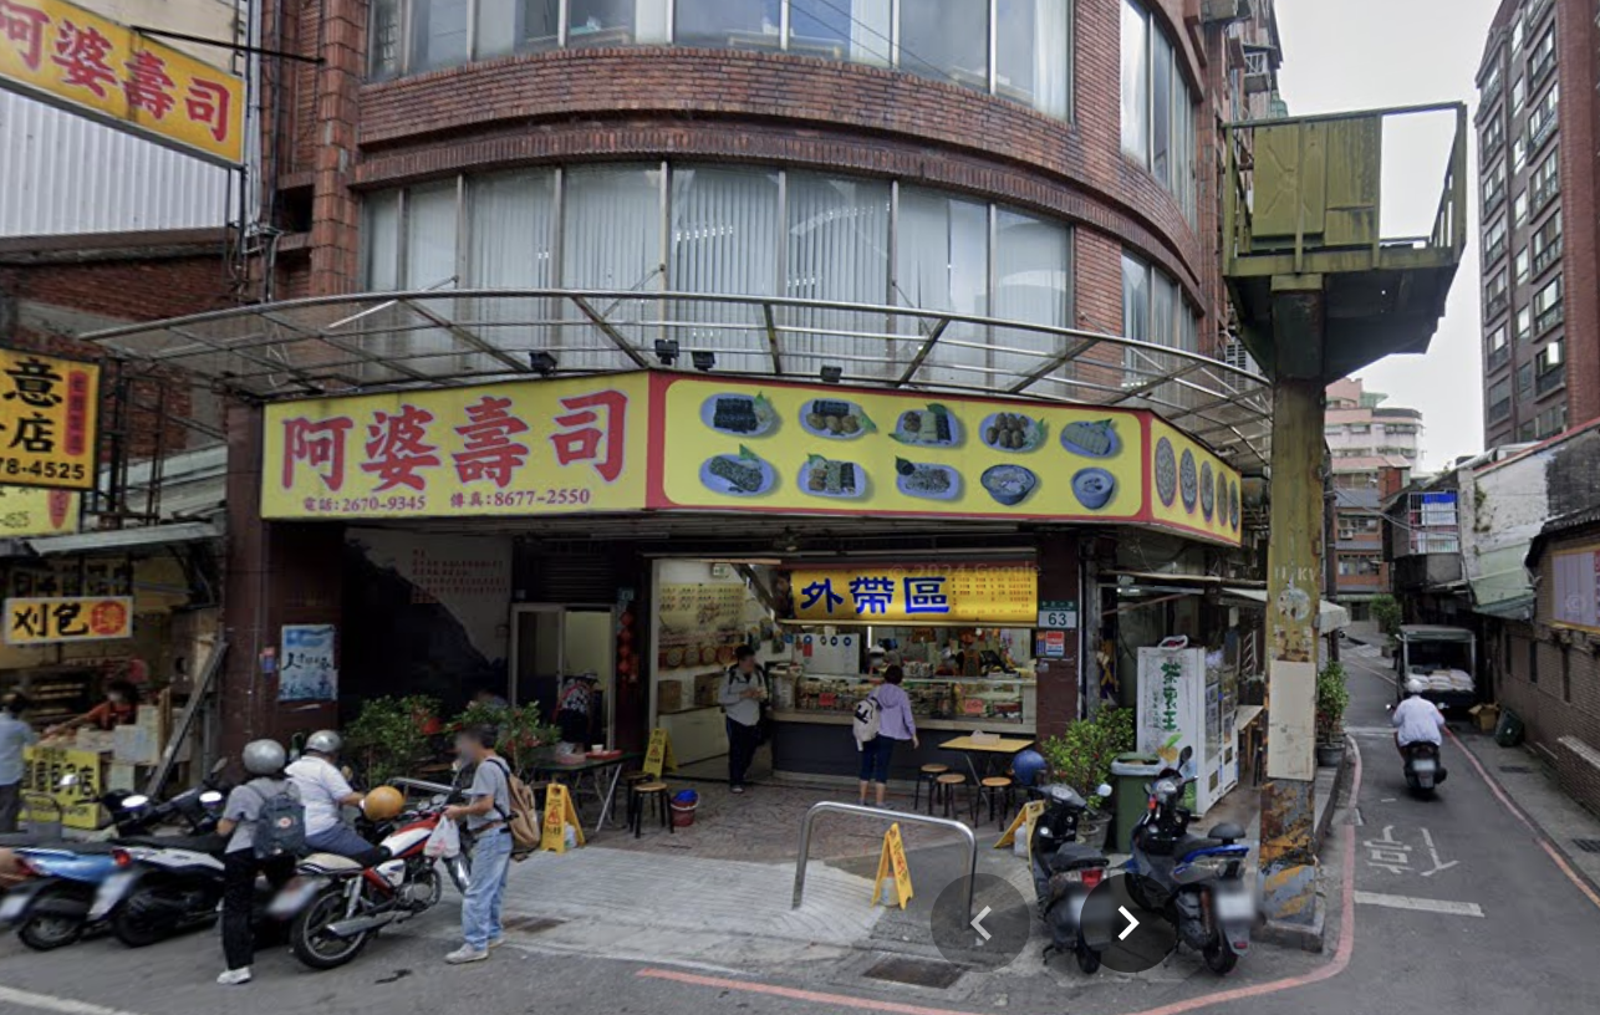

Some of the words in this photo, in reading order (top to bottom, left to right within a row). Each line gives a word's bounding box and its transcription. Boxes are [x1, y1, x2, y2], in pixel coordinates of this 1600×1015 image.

[3, 357, 62, 407] 意
[0, 412, 54, 453] 店
[281, 389, 628, 492] 阿婆壽司
[801, 576, 950, 614] 外帶區
[13, 603, 90, 637] 刈包
[1048, 612, 1067, 626] 63
